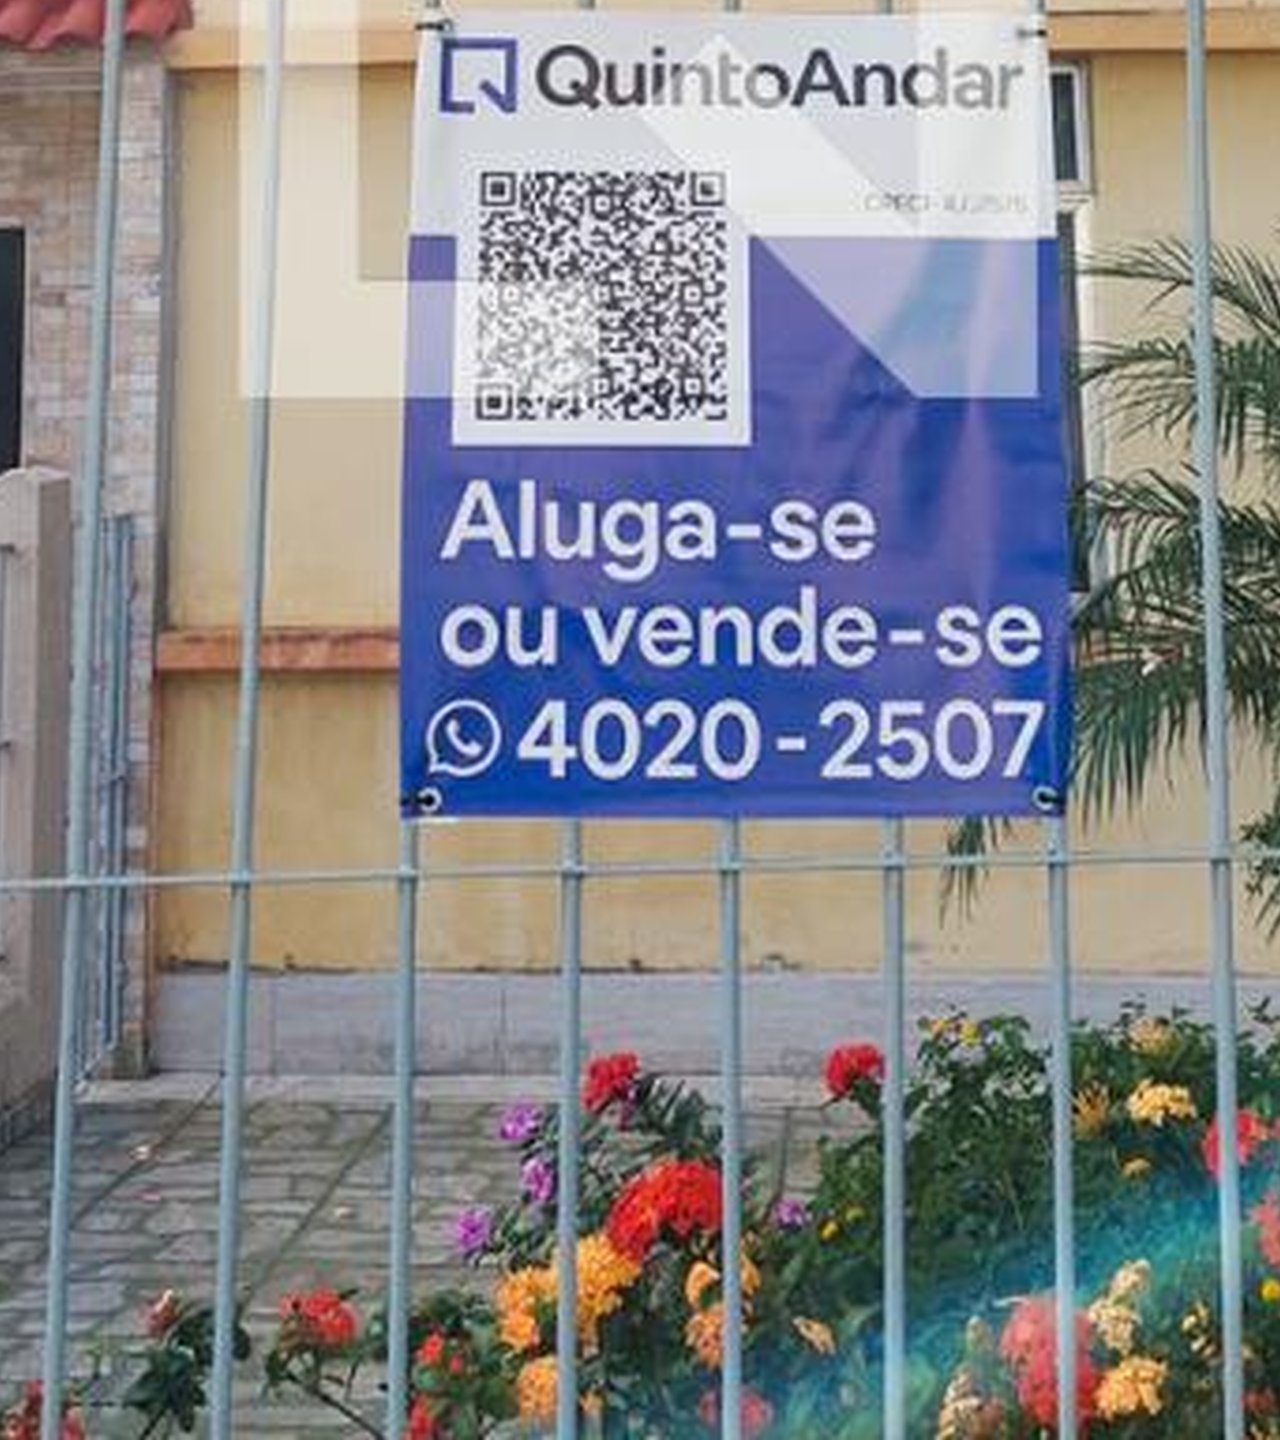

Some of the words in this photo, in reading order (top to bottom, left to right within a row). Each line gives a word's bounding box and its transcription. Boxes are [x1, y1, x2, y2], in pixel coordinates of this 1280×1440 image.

[535, 44, 1024, 109] QuintoAndar
[440, 478, 877, 582] Aluga-se
[440, 604, 558, 667] ou
[584, 587, 1042, 667] vende-se
